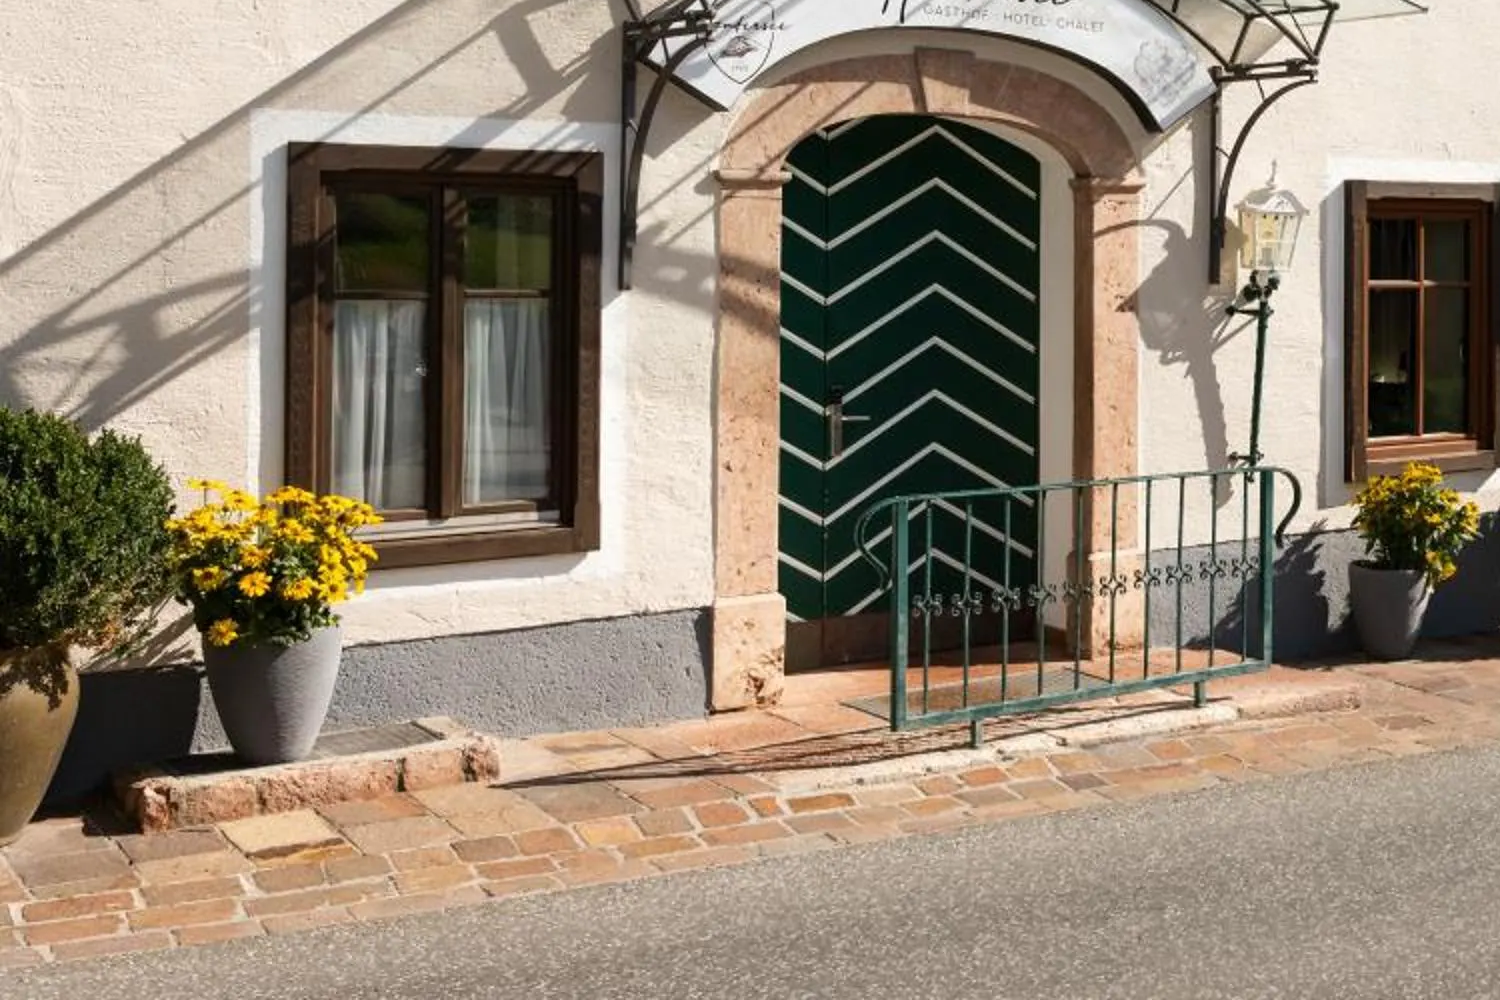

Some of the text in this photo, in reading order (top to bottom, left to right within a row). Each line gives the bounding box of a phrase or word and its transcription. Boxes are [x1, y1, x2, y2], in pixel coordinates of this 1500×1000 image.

[923, 3, 1106, 33] GASTHOF HOTEL CHALET
